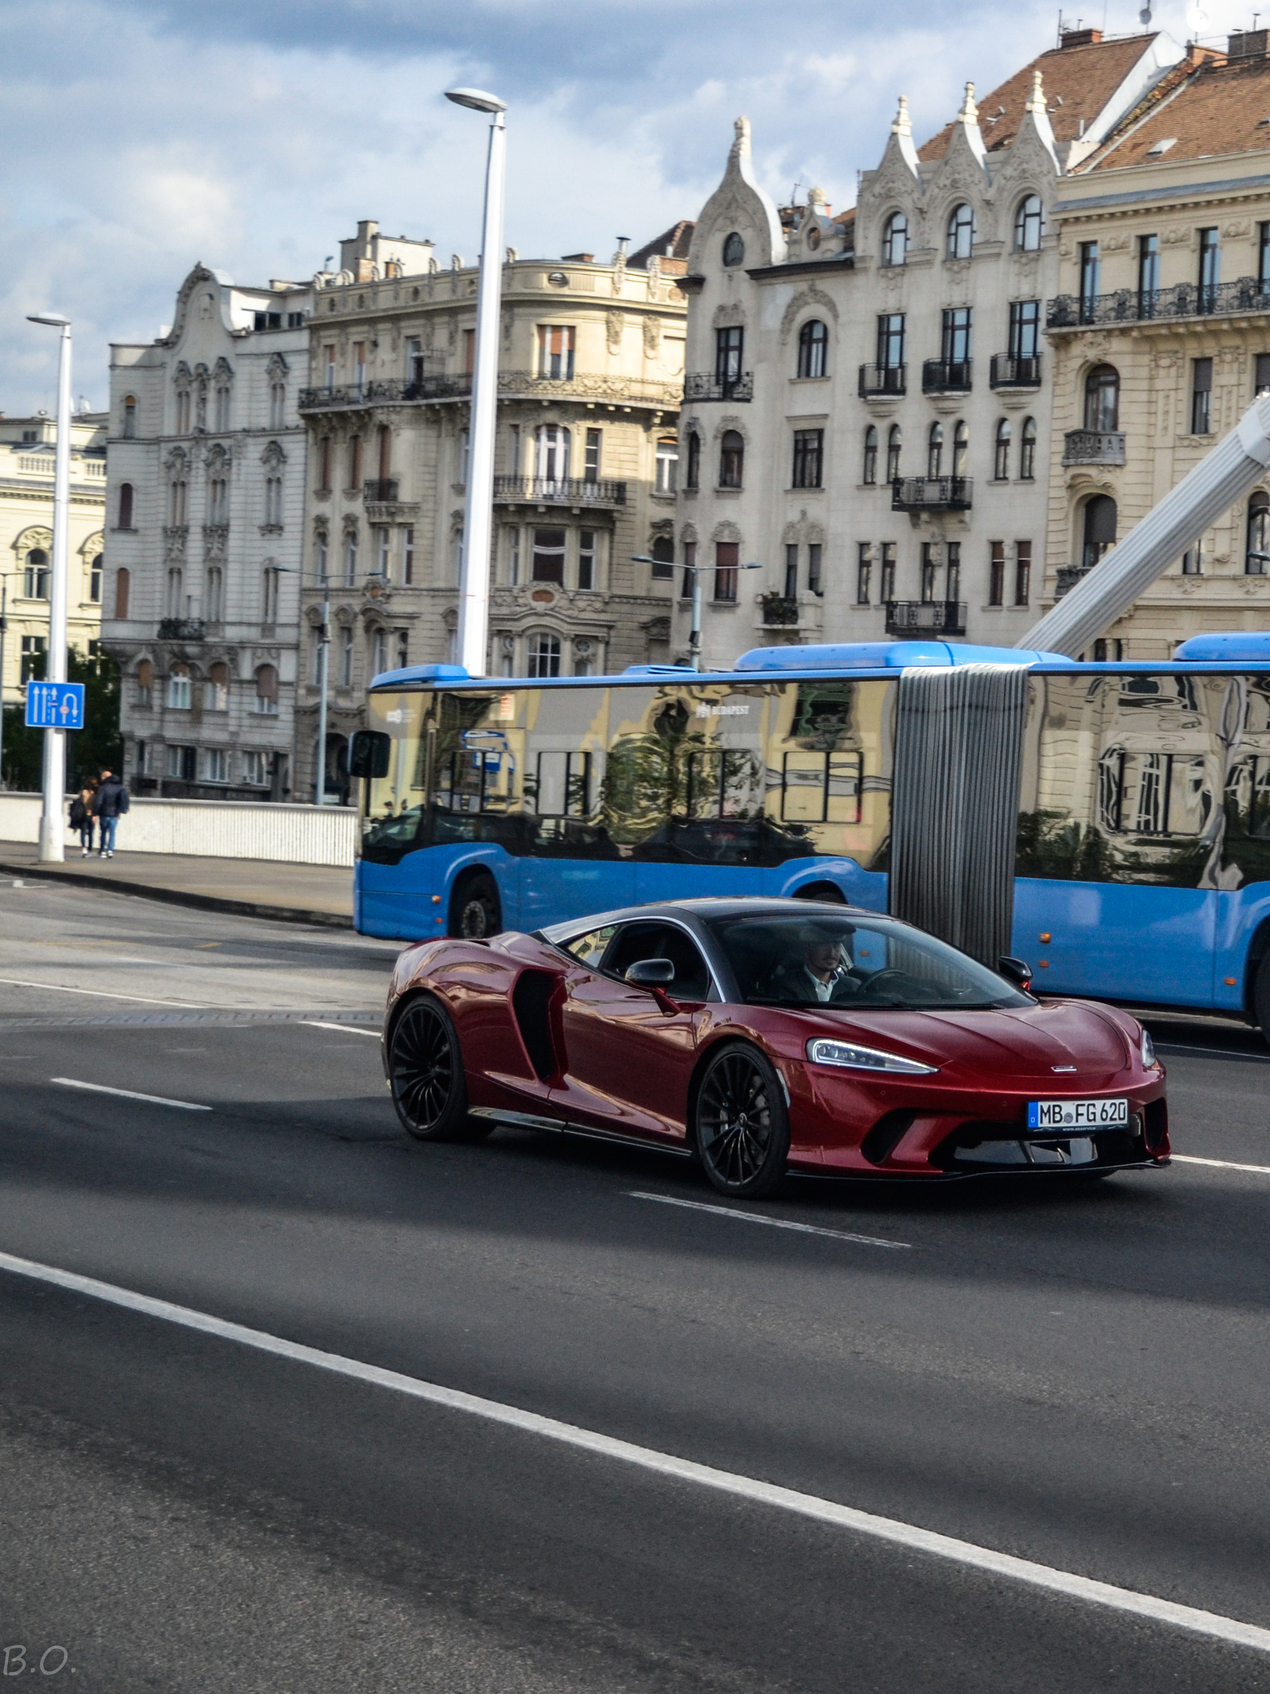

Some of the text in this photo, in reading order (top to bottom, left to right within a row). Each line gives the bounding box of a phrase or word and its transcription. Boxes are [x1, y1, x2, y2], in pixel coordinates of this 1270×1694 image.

[1039, 1104, 1063, 1124] MB
[1075, 1103, 1097, 1123] FG
[1100, 1101, 1126, 1122] 620
